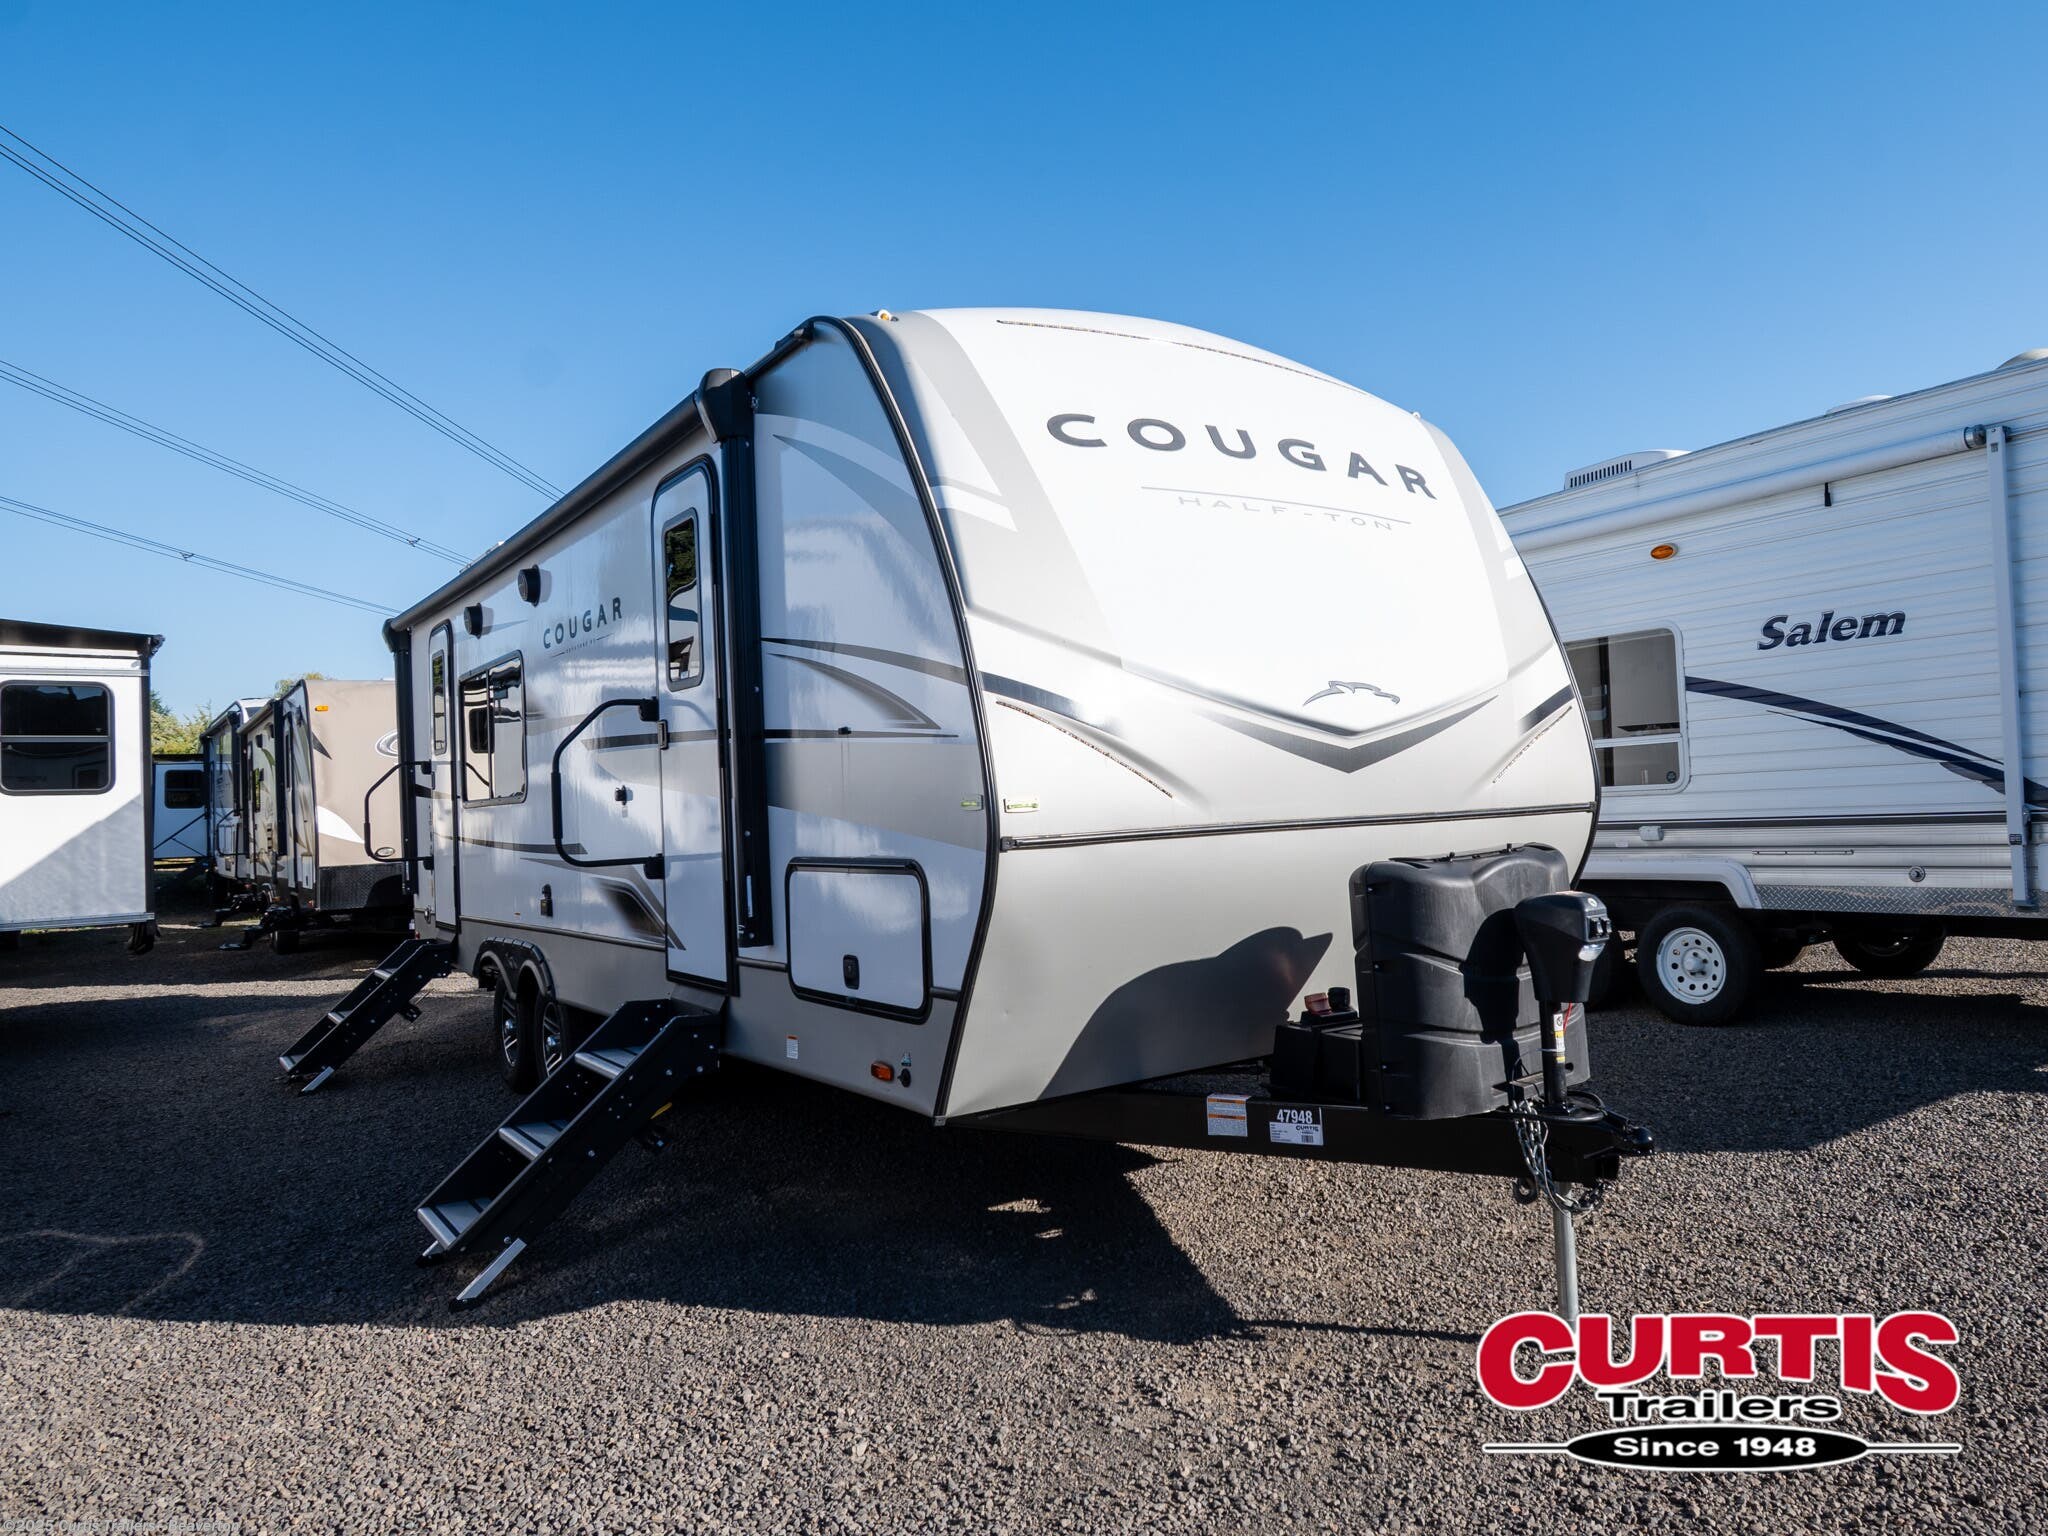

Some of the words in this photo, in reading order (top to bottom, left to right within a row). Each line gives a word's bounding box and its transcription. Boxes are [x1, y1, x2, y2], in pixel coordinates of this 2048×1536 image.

[1046, 413, 1437, 500] COUGAR
[1177, 495, 1393, 532] HALF-TON
[542, 596, 623, 650] COUGAR
[1756, 610, 1906, 651] Salem
[1276, 1108, 1313, 1124] 47948
